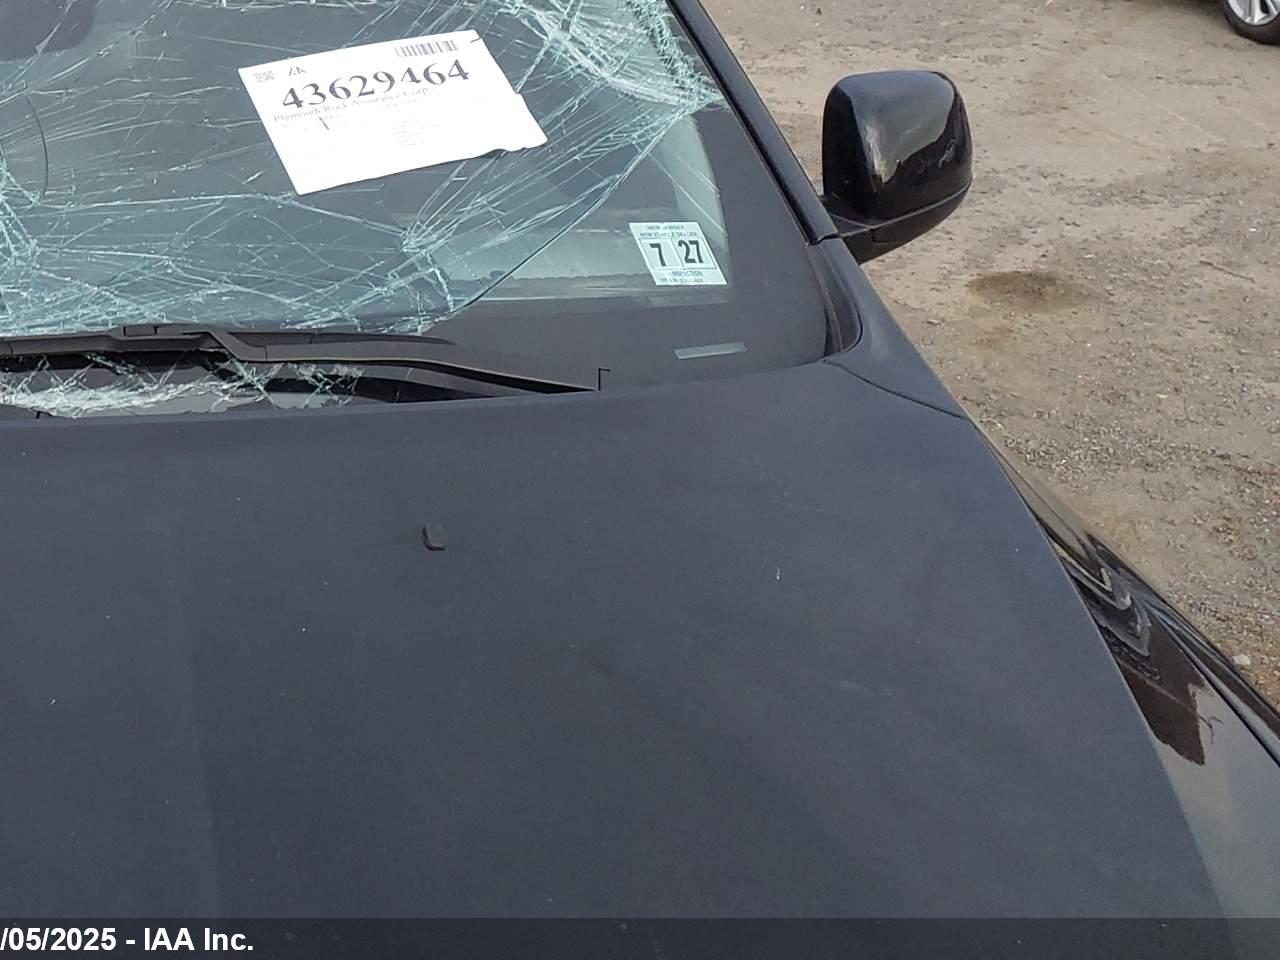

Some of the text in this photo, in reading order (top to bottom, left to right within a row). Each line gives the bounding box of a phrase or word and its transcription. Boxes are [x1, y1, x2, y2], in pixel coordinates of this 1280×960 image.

[282, 59, 470, 110] 43629464
[649, 240, 704, 267] 7 27
